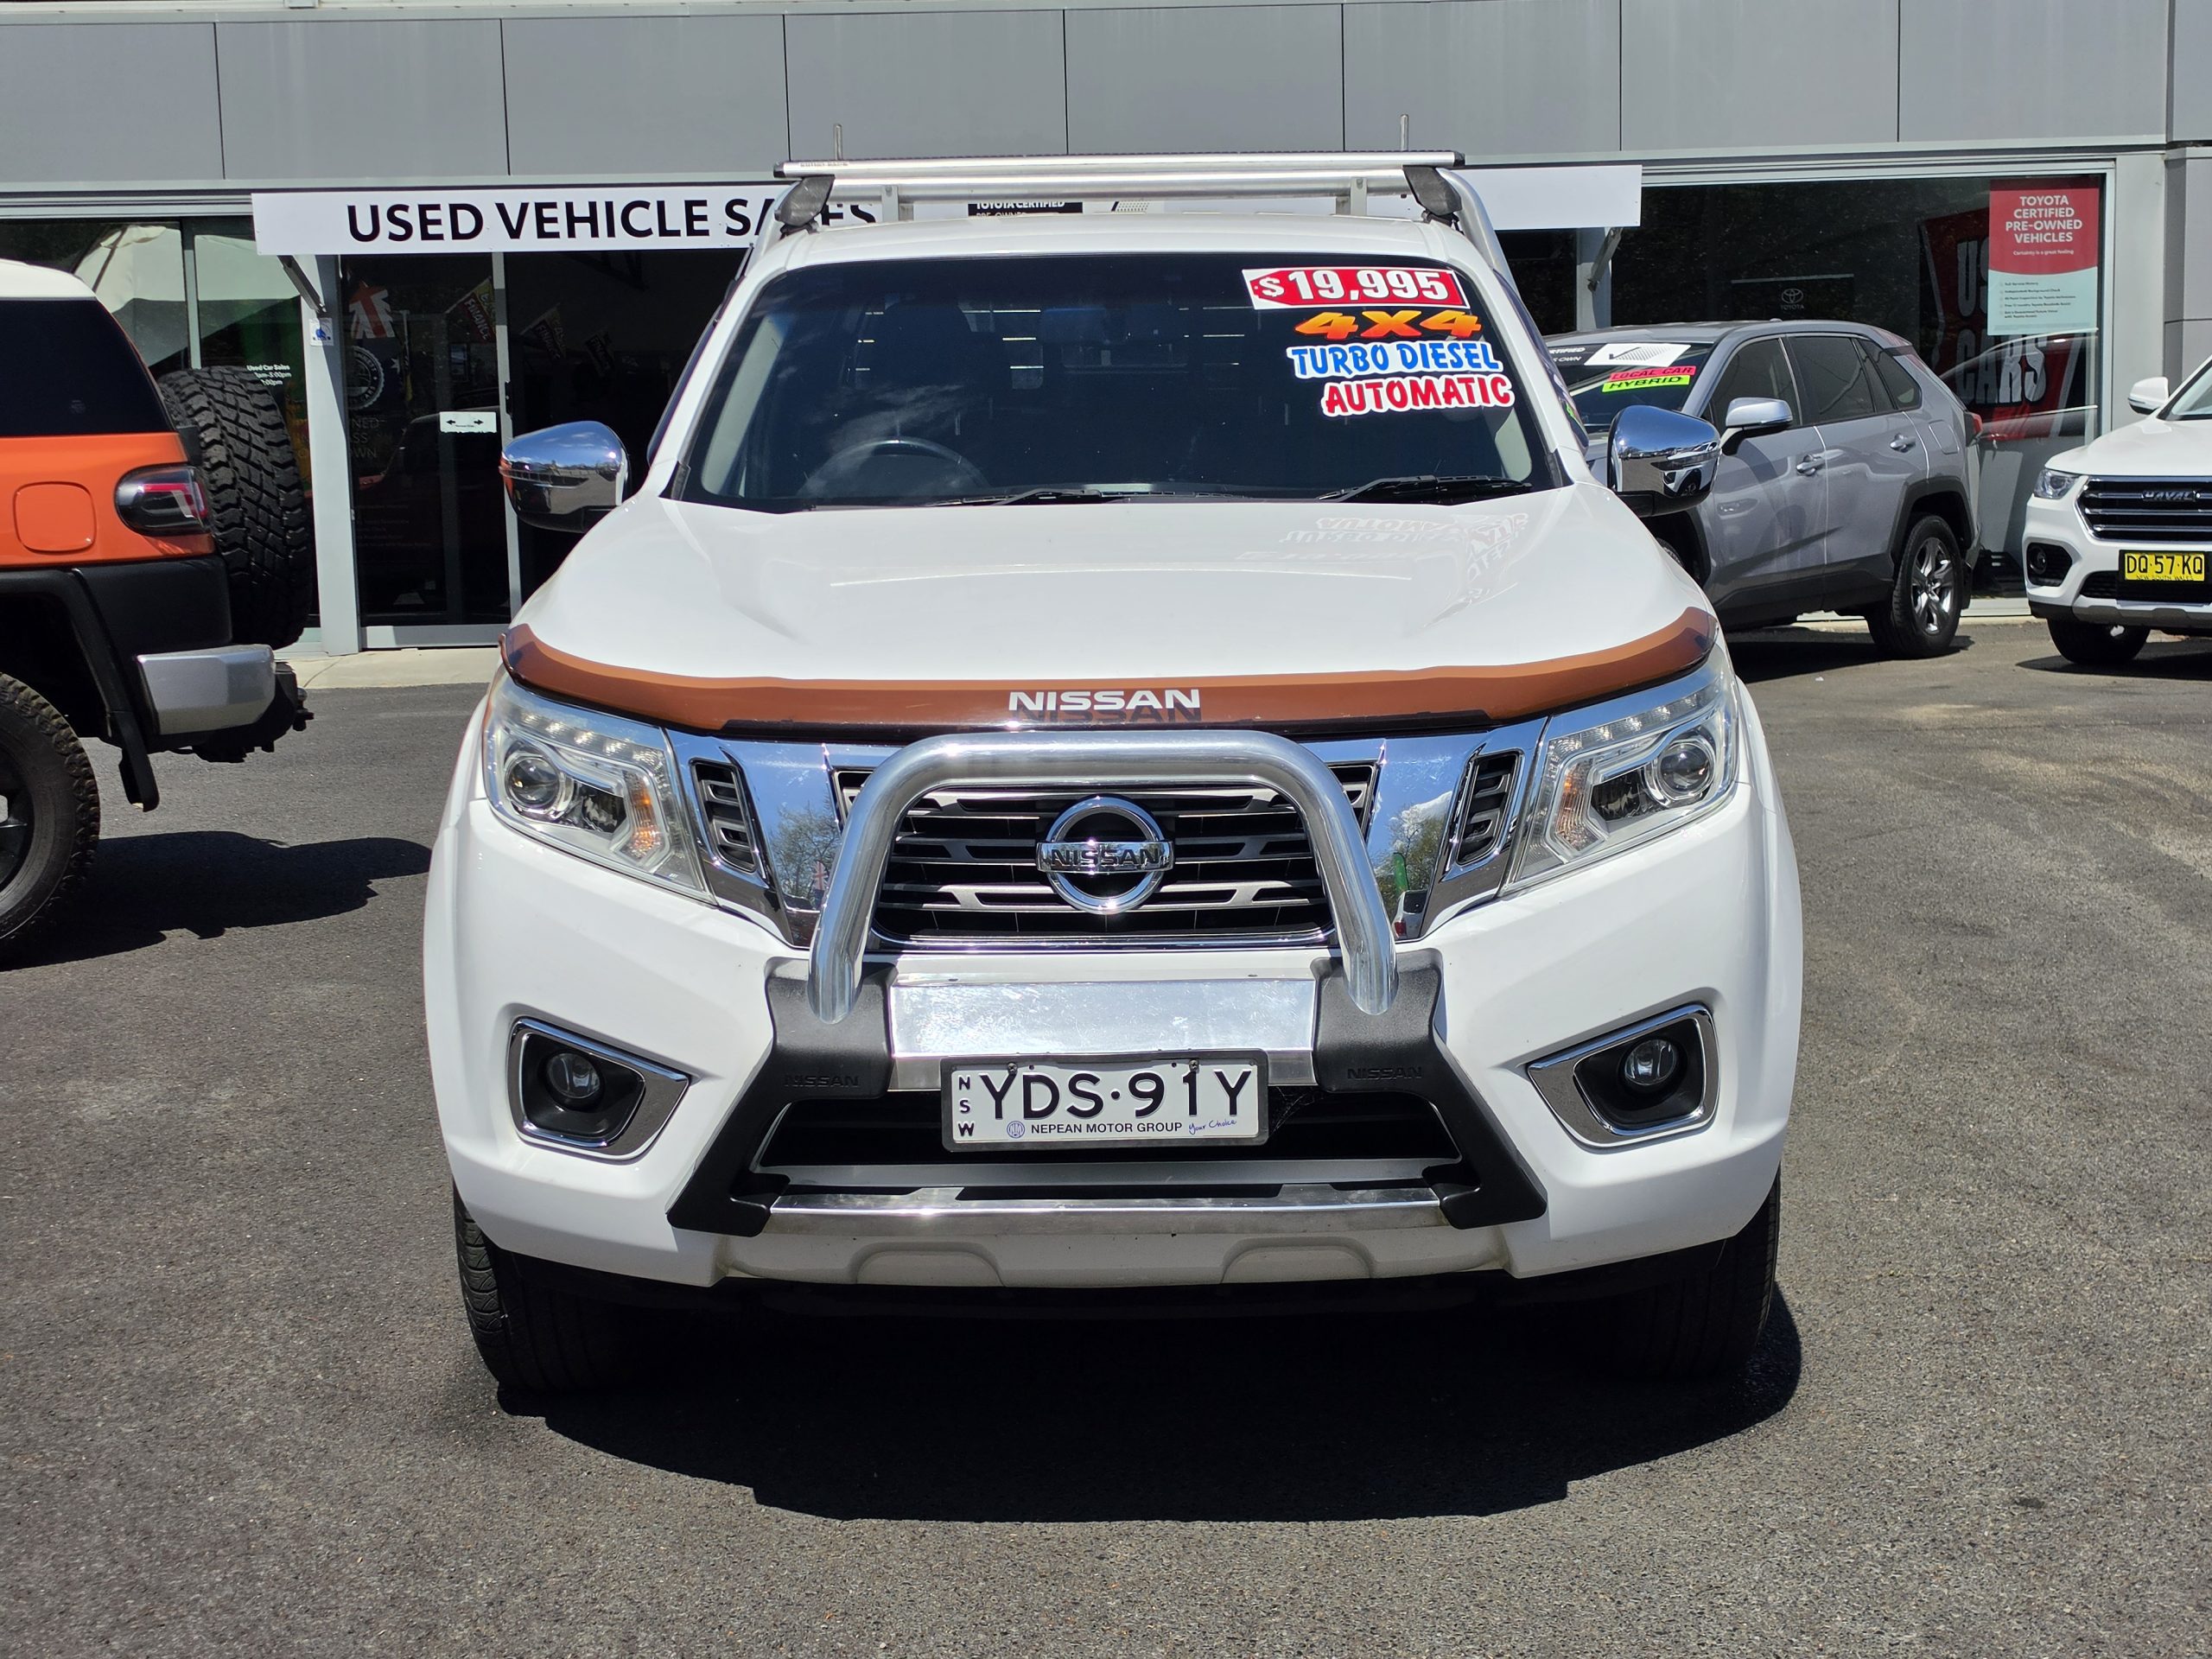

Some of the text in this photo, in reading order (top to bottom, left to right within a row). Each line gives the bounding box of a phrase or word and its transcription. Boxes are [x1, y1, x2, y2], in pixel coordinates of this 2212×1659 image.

[2019, 195, 2069, 206] TOYOTA
[347, 198, 876, 242] USED VEHICLE SES
[2013, 207, 2075, 219] CERTIFIED
[2005, 219, 2082, 232] PRE-OWNED
[2014, 232, 2073, 243] VEHICLES
[1259, 270, 1449, 300] $19,995
[1294, 309, 1482, 340] 4X4
[1292, 342, 1499, 375] TURBO DIESEL
[1955, 327, 2046, 404] CARS
[1611, 369, 1656, 379] LOCAL
[1609, 376, 1682, 389] HYBRID
[1325, 377, 1510, 414] AUTOMATIC
[1008, 689, 1200, 711] NISSAN
[1051, 849, 1159, 867] NISSAN
[784, 1075, 860, 1087] NISSAN
[1347, 1066, 1422, 1080] NISSAN
[1031, 1119, 1236, 1135] NEPEAN MOTOR GROUP Your Choice
